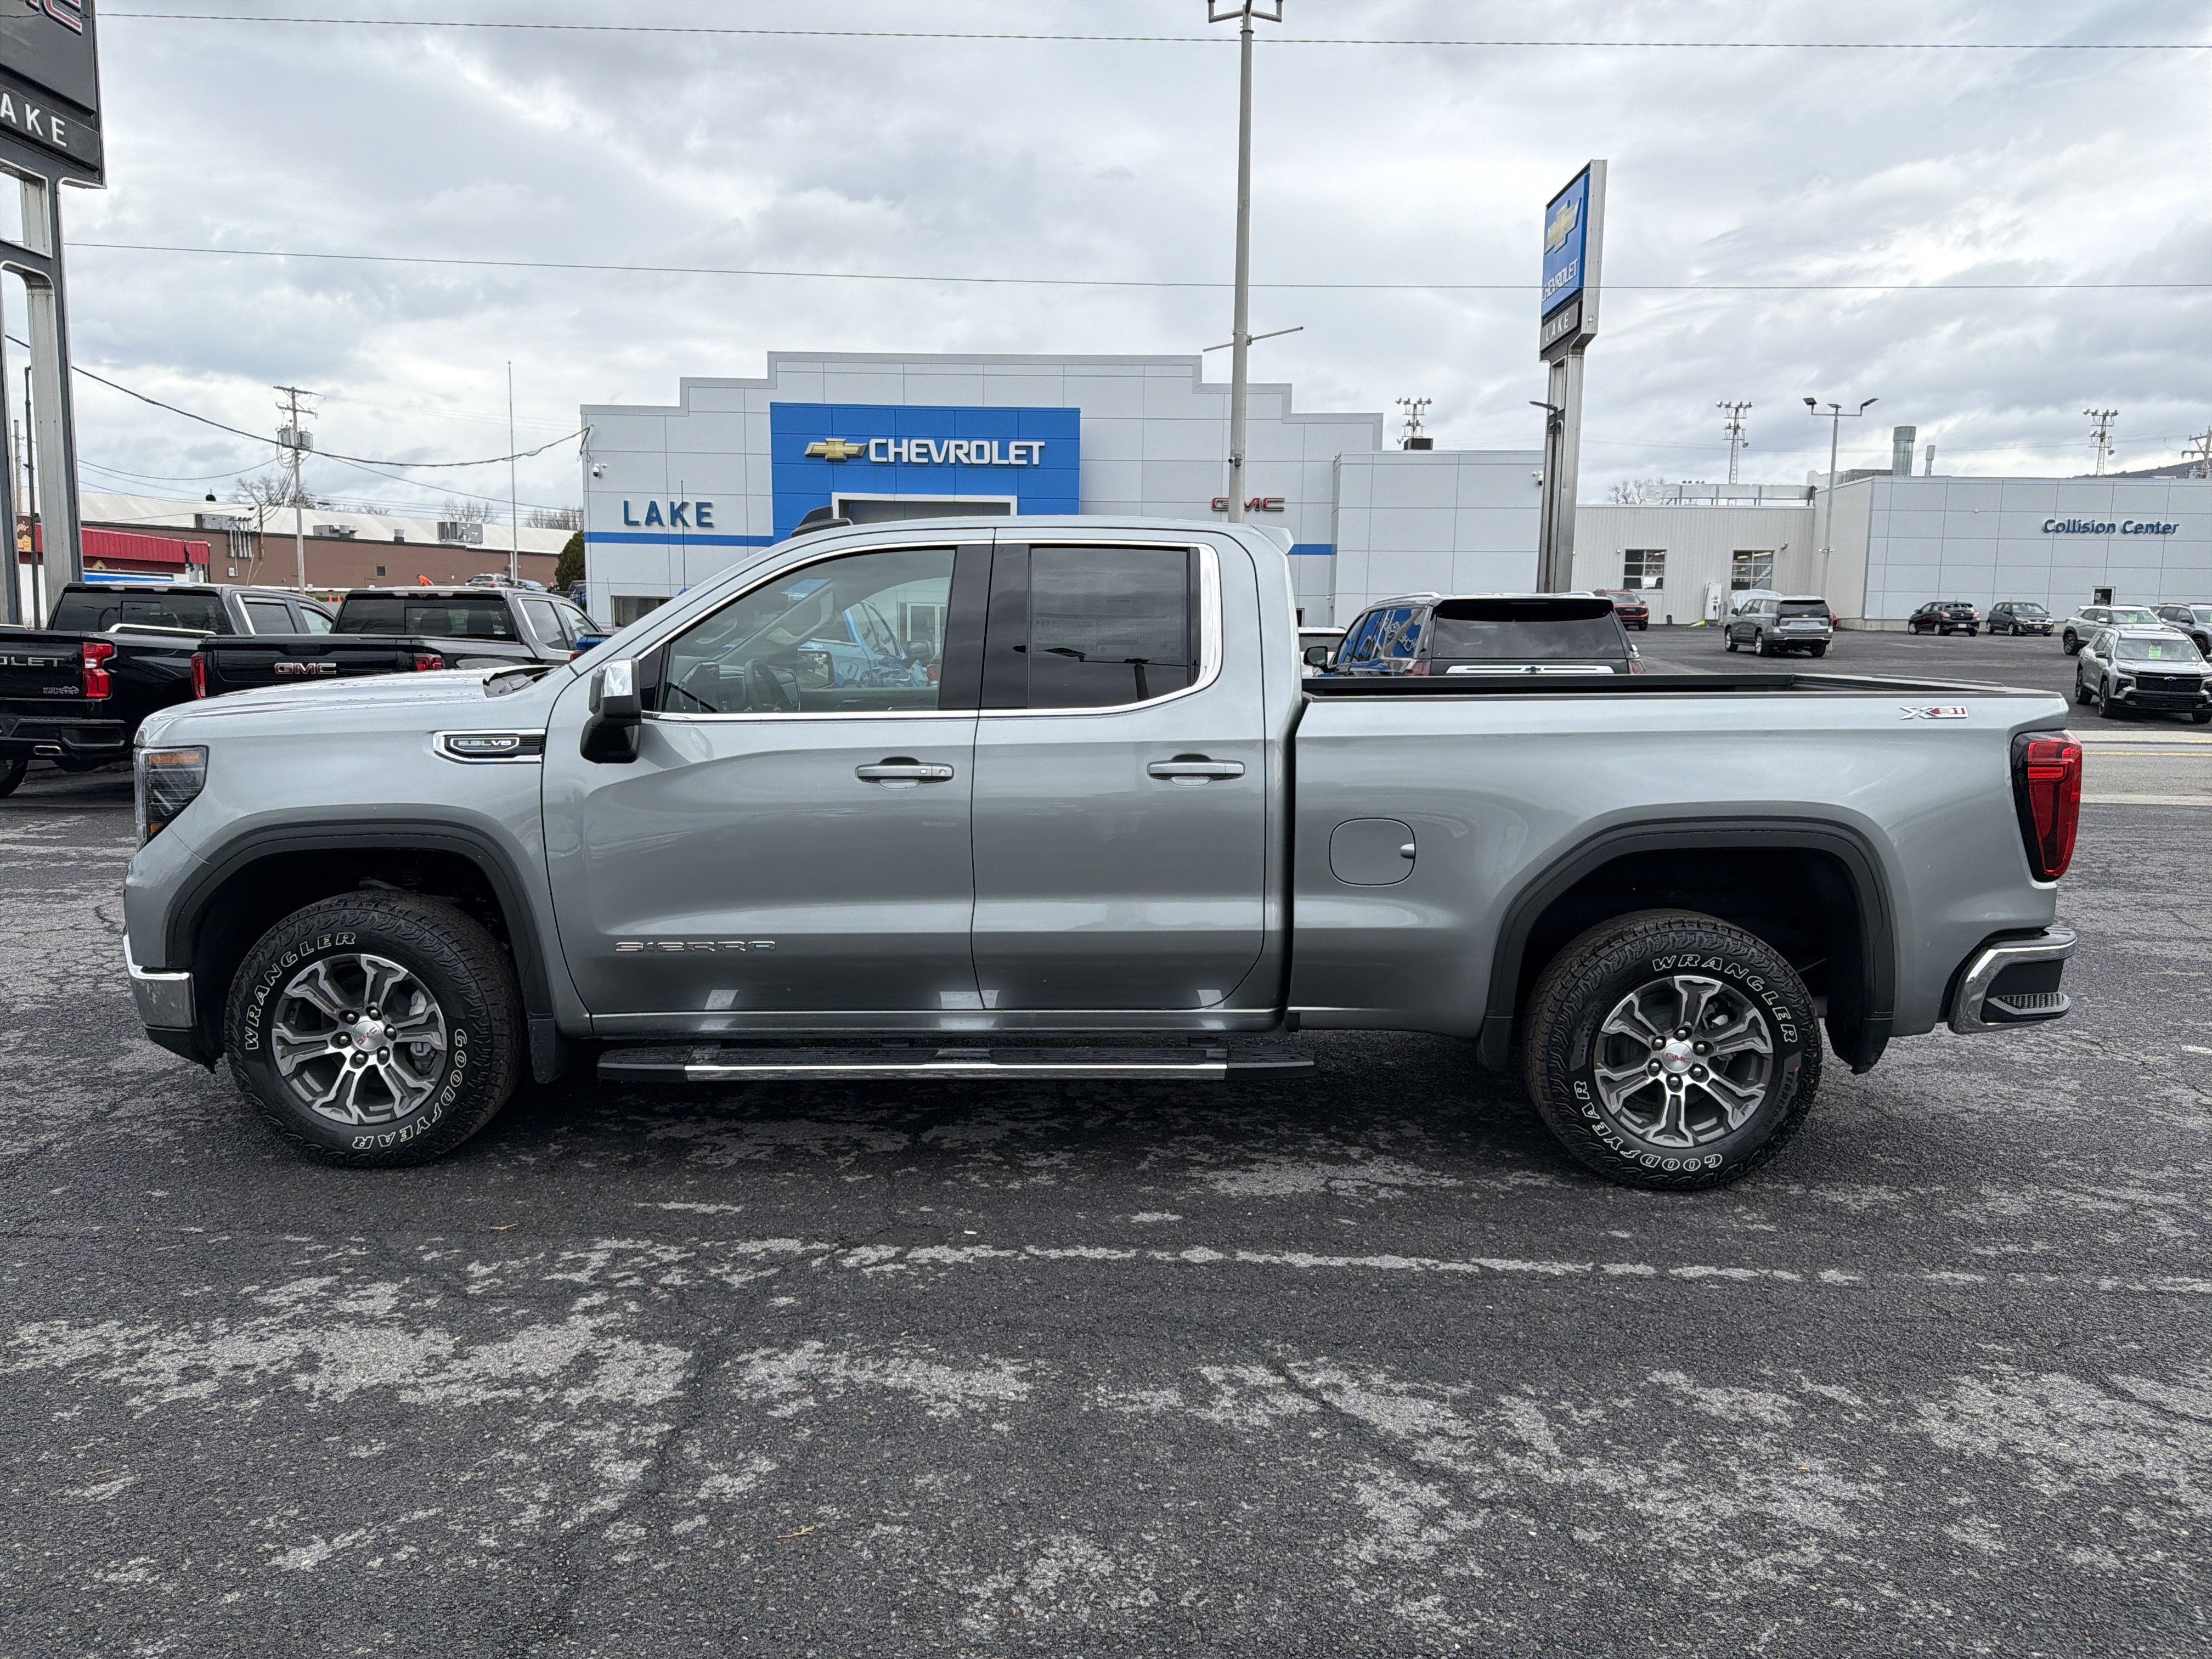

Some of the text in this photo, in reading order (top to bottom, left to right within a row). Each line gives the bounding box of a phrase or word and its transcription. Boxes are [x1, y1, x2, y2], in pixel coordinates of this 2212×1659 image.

[1542, 258, 1578, 302] CHEVROLET
[1545, 312, 1569, 342] LAKE
[869, 438, 1046, 465] CHEVROLET
[623, 500, 714, 528] LAKE
[2043, 518, 2180, 535] Collision Center
[274, 662, 337, 675] GMC
[1899, 706, 1969, 720] X31
[616, 941, 775, 952] SIERRA
[245, 932, 356, 1050] WRANGLER
[1652, 953, 1798, 1043] WRANGLER
[357, 1026, 377, 1046] GMC
[1666, 1053, 1691, 1063] GMC
[352, 1029, 467, 1149] GOODYEAR
[1573, 1080, 1723, 1172] GOODYEAR
